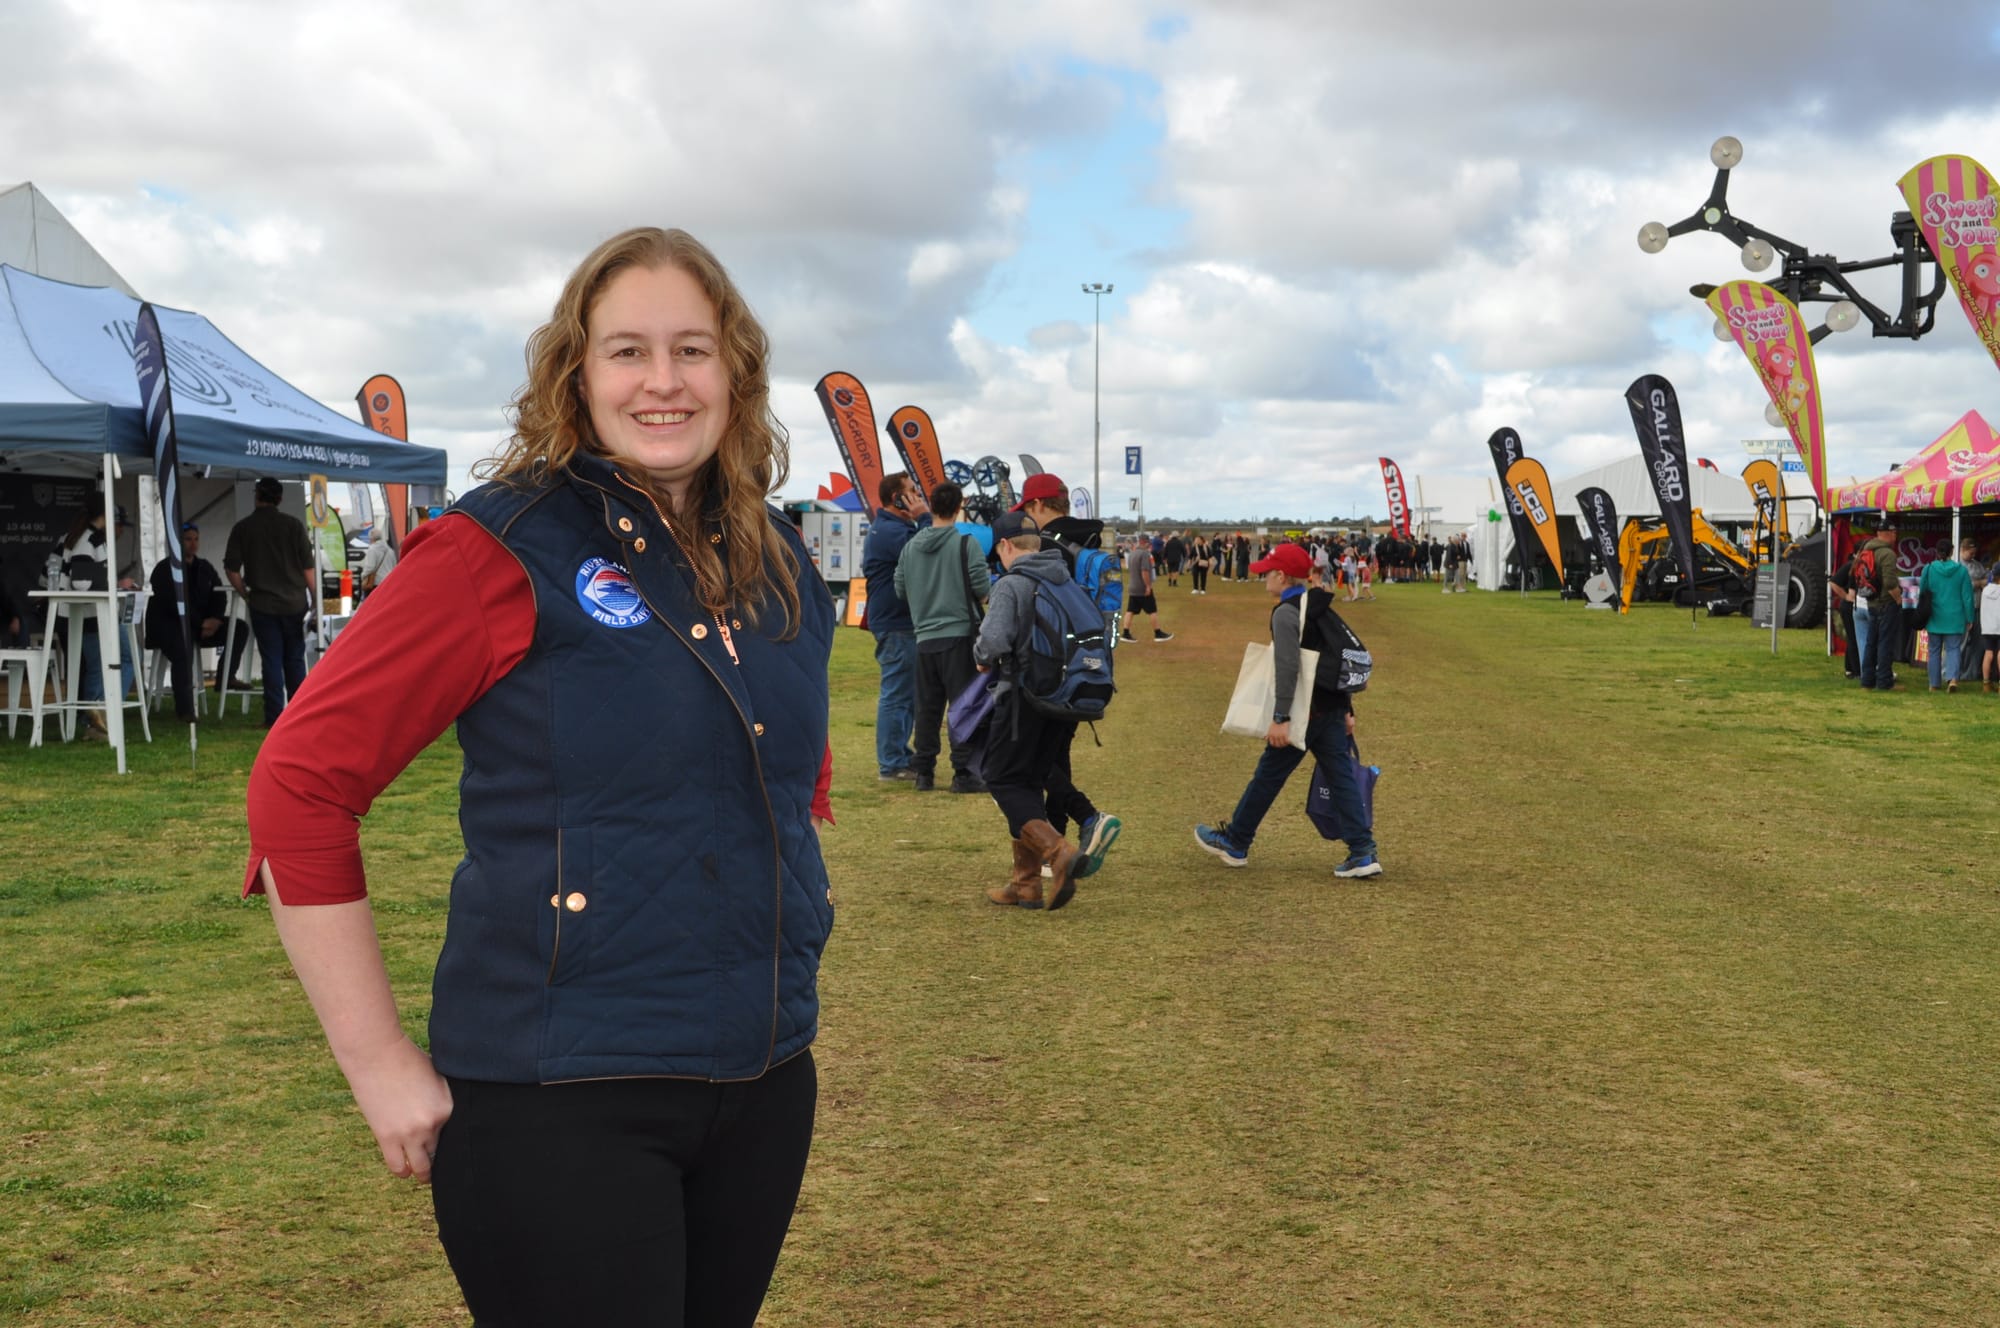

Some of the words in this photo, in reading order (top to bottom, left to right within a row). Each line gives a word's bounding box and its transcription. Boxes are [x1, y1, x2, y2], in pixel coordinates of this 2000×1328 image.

[1924, 192, 1997, 227] Sweet
[1962, 219, 1982, 227] and
[1942, 220, 1998, 248] Sour
[1728, 304, 1786, 328] Sweet
[1950, 266, 1962, 281] the
[1959, 281, 1981, 315] original
[1976, 315, 1995, 342] candy
[1746, 322, 1788, 342] Sour
[1759, 320, 1773, 328] and
[245, 440, 259, 455] 13
[844, 410, 875, 468] AGRIDRY
[1651, 389, 1683, 502] GALLARD
[911, 441, 937, 487] AGRIDR
[1129, 456, 1138, 472] 7
[1788, 463, 1805, 471] FOO
[1654, 461, 1670, 503] GROUP
[1130, 498, 1137, 511] 7
[1384, 465, 1404, 528] TOOLS
[1517, 482, 1548, 525] JCB
[1594, 493, 1615, 556] GALLARD
[592, 609, 628, 626] FIELD
